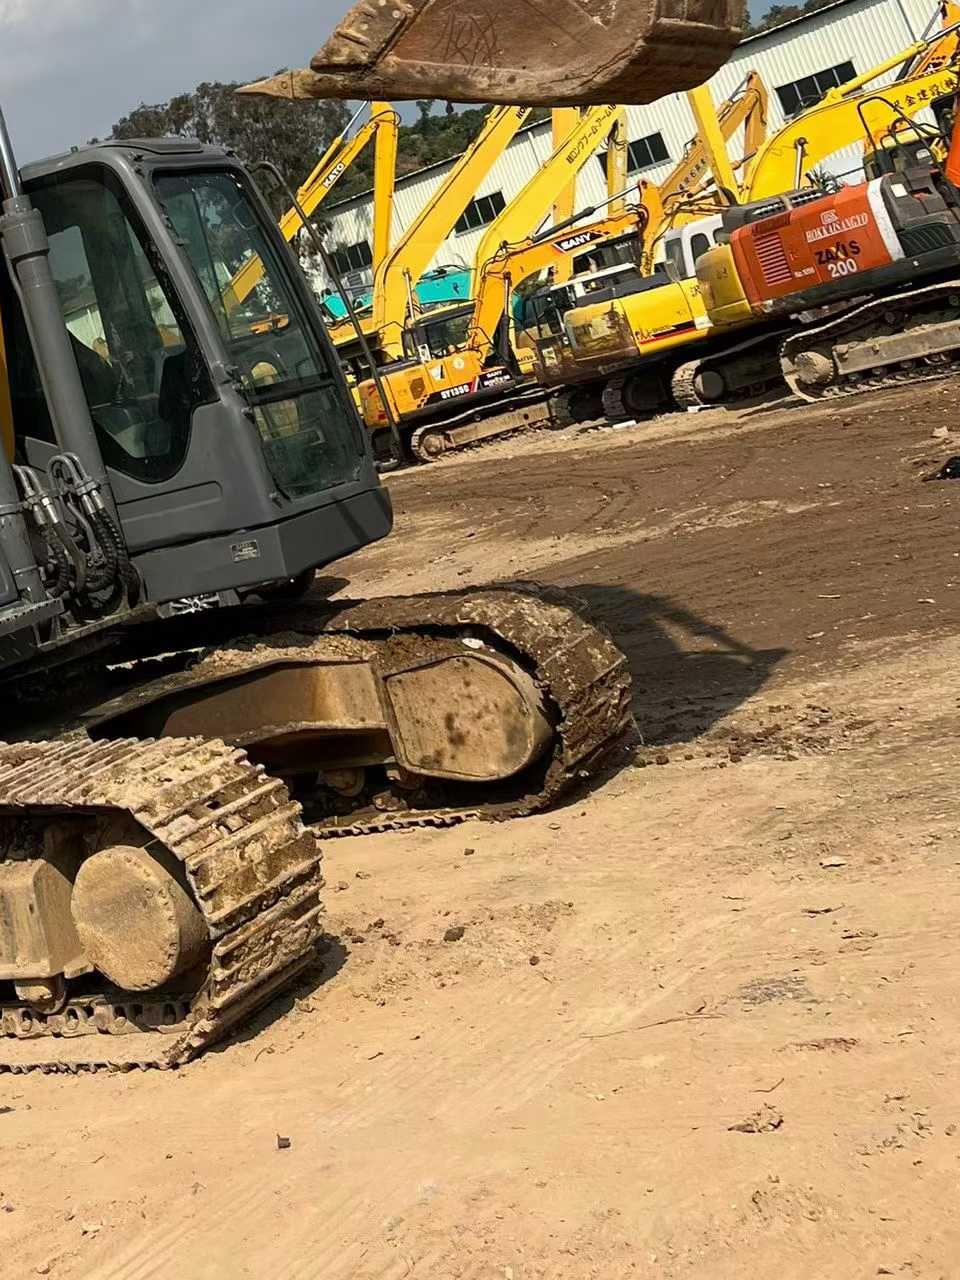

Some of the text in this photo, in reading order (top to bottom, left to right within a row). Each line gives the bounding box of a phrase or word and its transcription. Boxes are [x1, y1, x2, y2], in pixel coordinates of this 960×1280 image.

[323, 162, 345, 188] KATO
[560, 232, 591, 251] SANY
[815, 240, 861, 265] ZAXIS
[828, 258, 858, 278] 200
